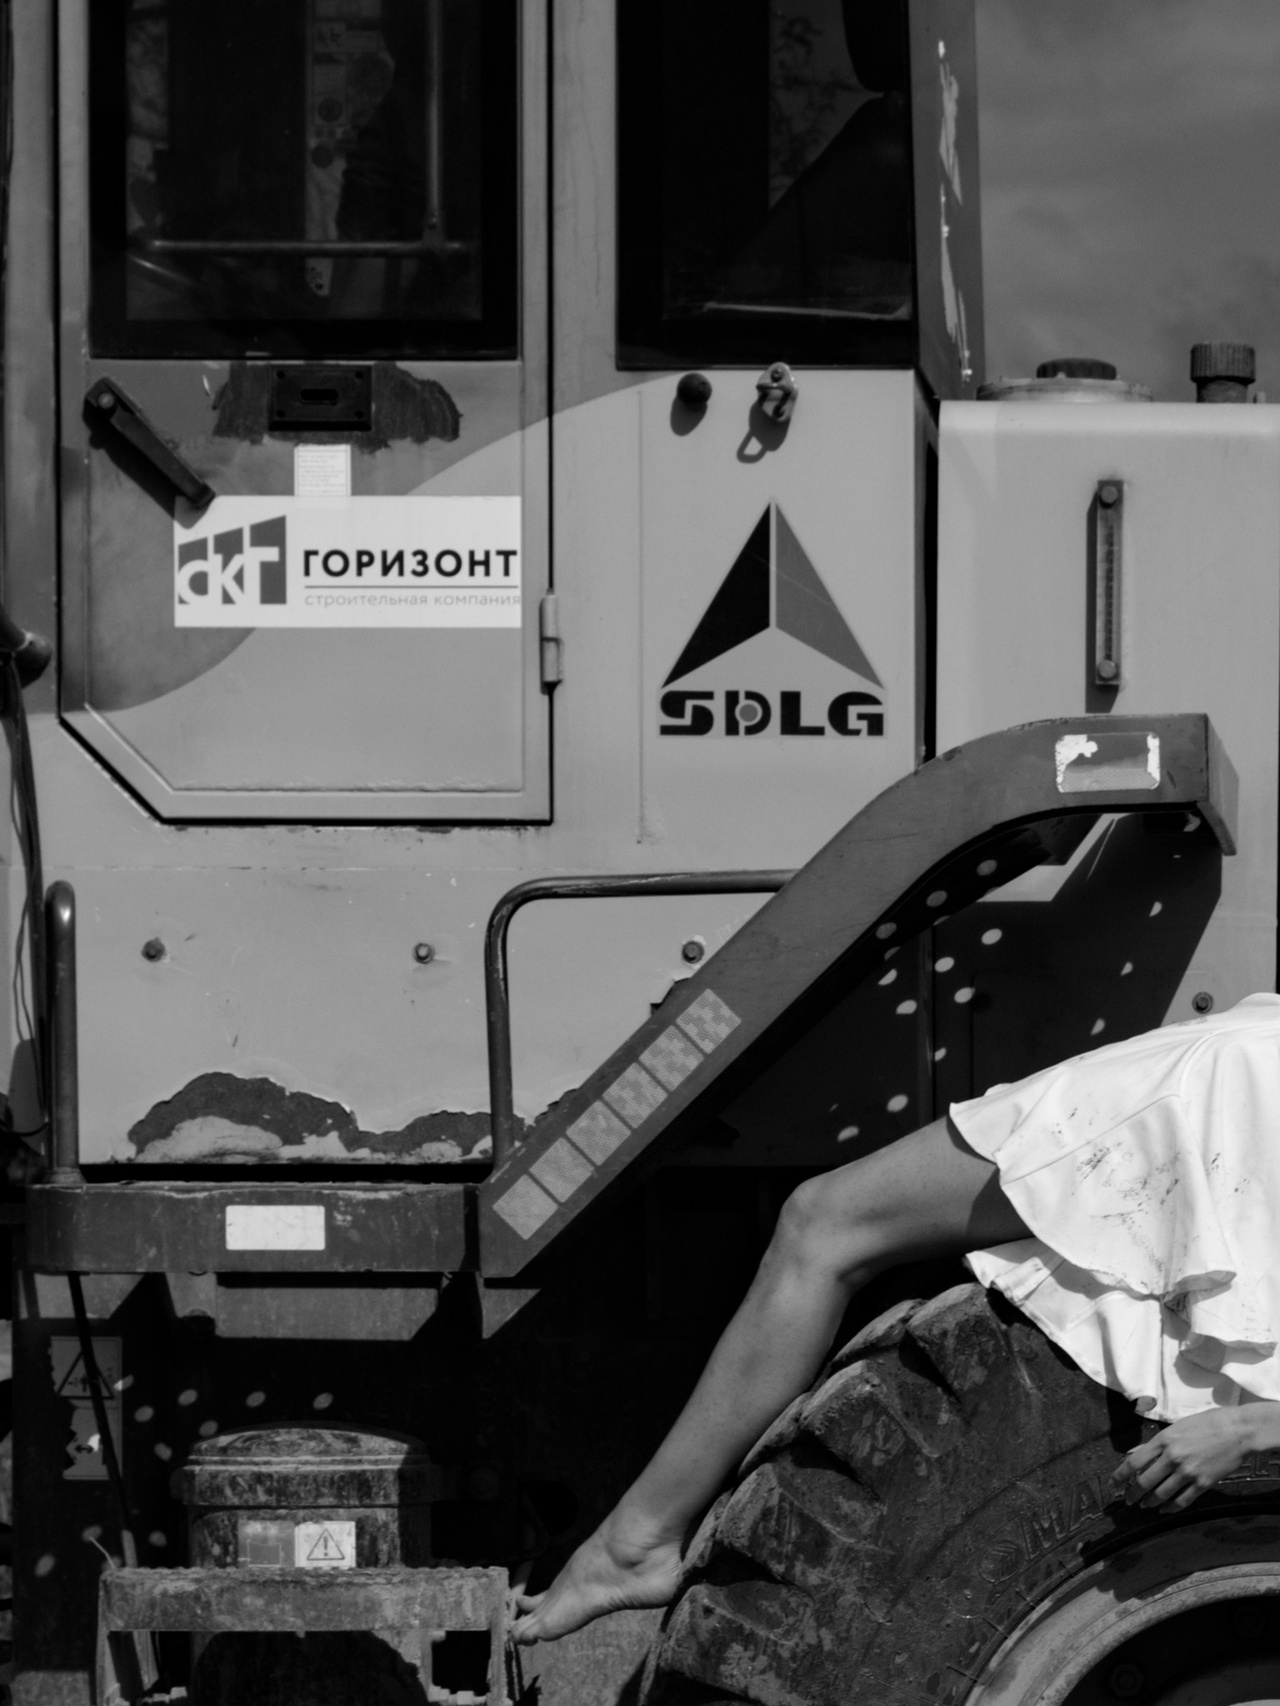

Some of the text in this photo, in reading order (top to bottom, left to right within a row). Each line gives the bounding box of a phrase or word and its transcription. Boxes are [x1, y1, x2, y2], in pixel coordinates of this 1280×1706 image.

[303, 549, 518, 578] ГОРИЗОНТ
[304, 594, 521, 610] строительная компания
[660, 690, 884, 736] SDLG
